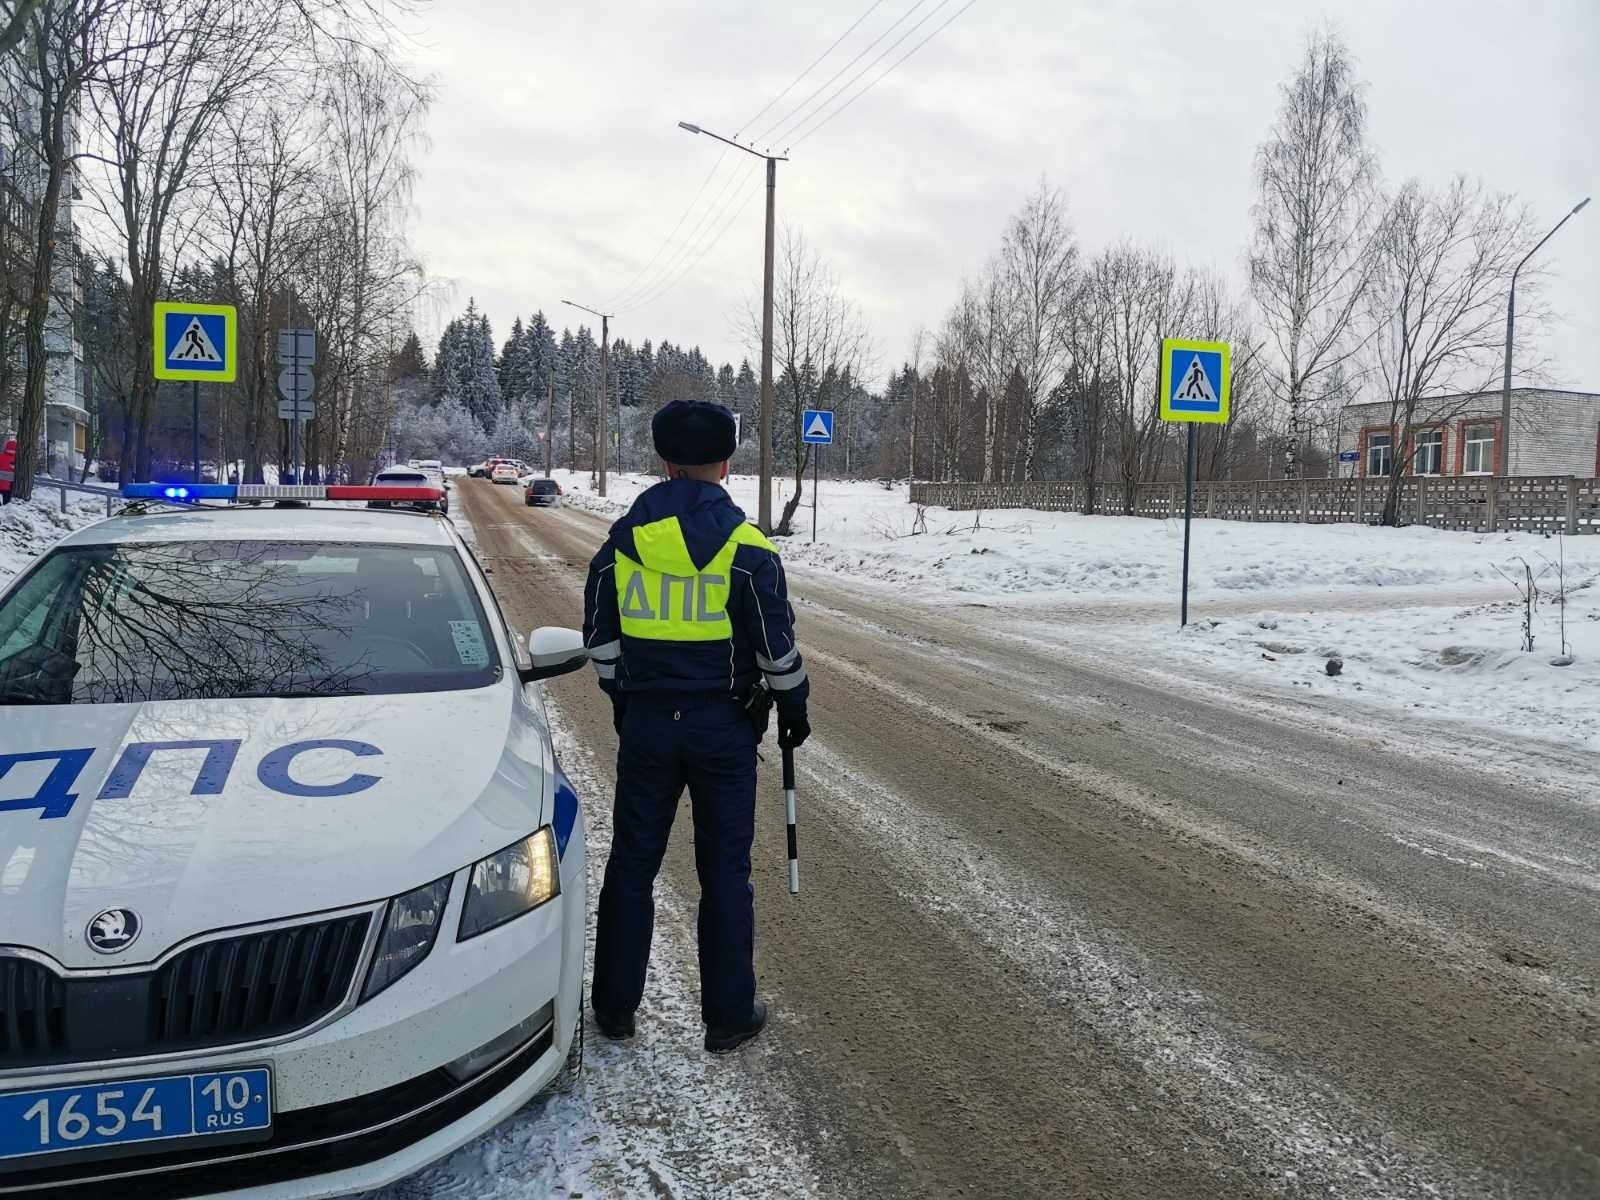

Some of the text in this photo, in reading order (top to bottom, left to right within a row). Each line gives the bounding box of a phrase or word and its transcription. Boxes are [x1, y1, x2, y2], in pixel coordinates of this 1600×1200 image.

[622, 570, 725, 621] ДПС
[22, 1076, 250, 1145] 1654 10
[207, 1112, 244, 1128] RUS
